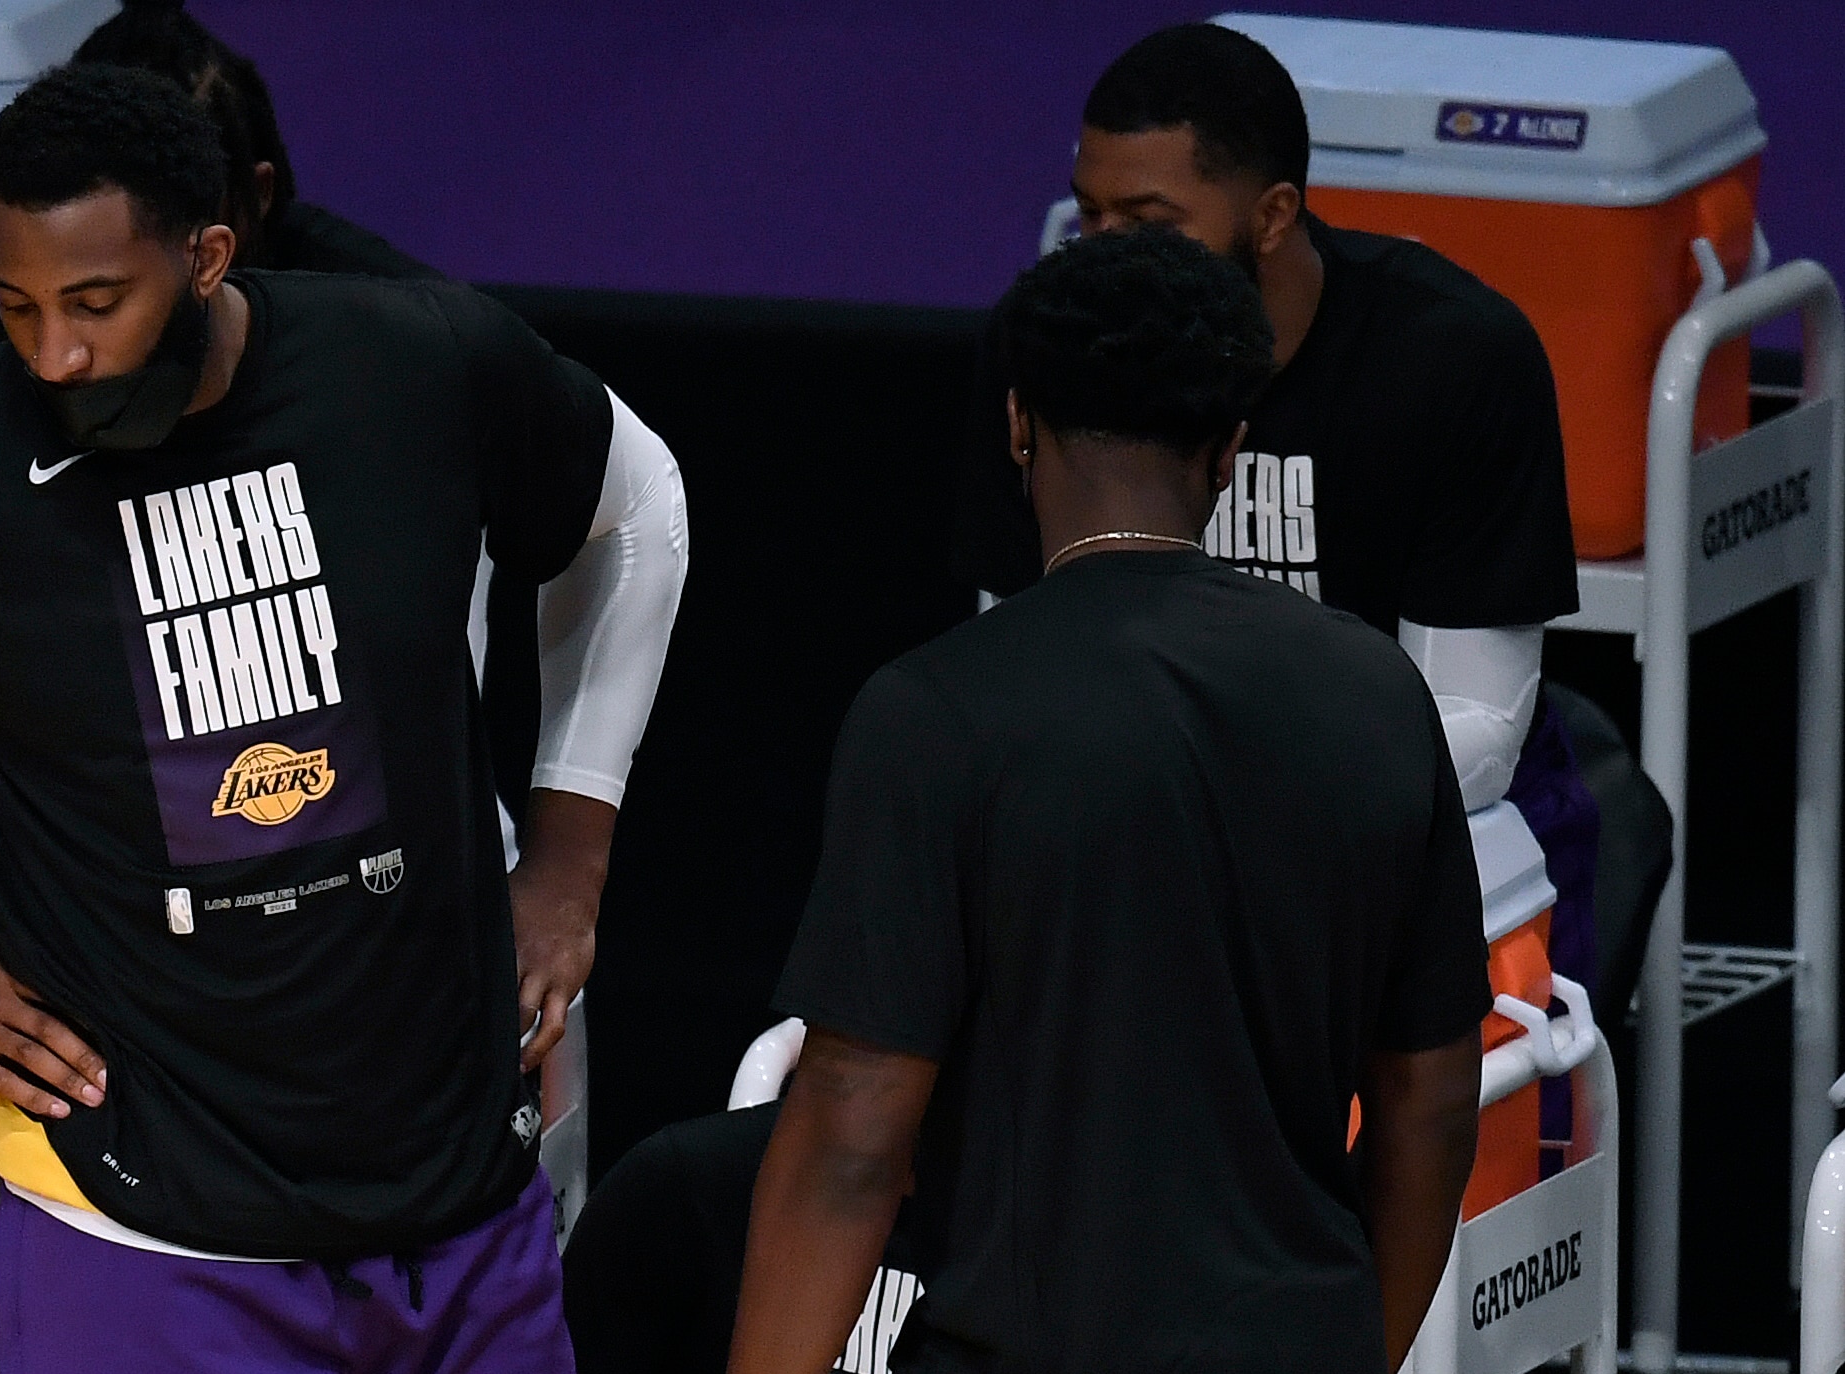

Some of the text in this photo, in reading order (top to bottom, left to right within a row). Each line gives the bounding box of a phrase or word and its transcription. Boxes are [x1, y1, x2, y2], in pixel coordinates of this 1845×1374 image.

[118, 461, 321, 616] LAKERS
[1203, 452, 1317, 563] KERS
[1702, 468, 1811, 560] GATORADE
[145, 584, 342, 741] FAMILY
[222, 764, 324, 811] LAKERS
[248, 753, 323, 776] LOS ANGELES
[204, 874, 350, 911] LOS ANGELES LAKERS
[1472, 1230, 1582, 1331] GATORADE
